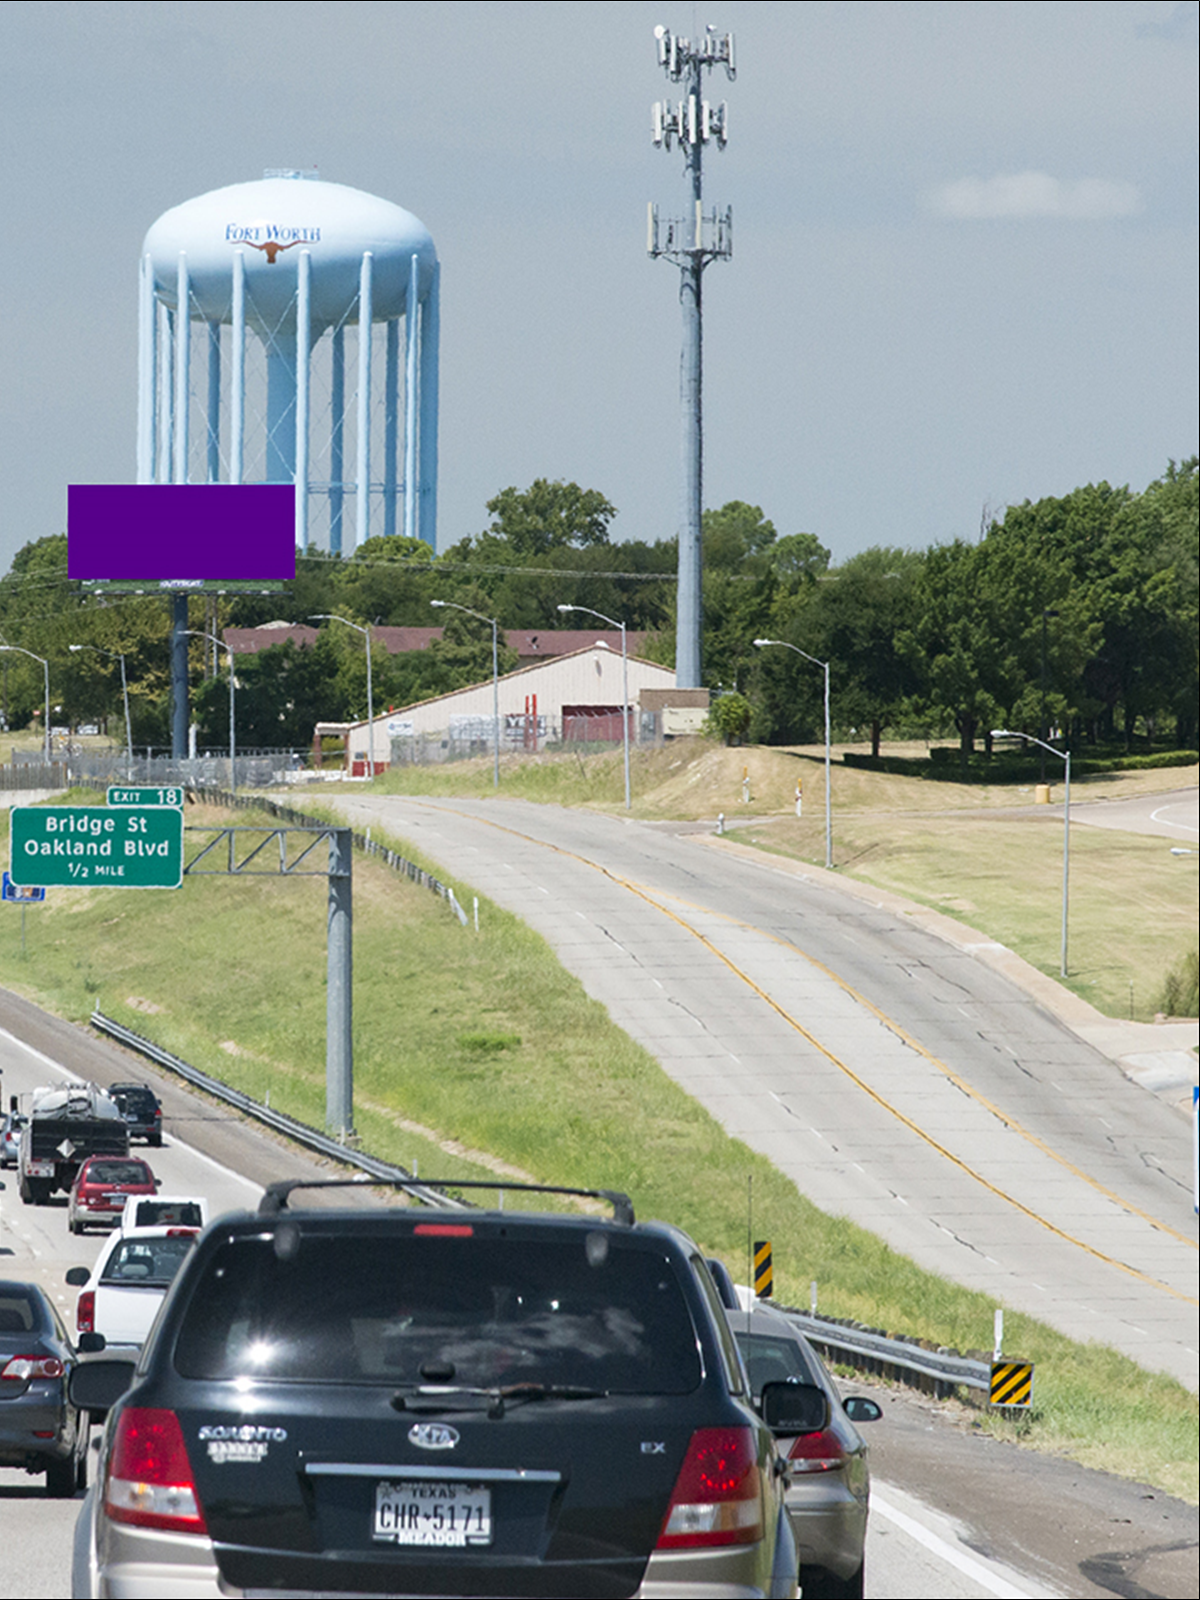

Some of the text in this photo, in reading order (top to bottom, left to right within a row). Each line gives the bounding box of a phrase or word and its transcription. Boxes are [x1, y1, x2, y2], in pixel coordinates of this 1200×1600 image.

[113, 789, 178, 805] EXIT 18
[45, 815, 148, 836] Bridge St
[24, 838, 169, 856] Oakland Blvd
[67, 862, 125, 878] 1/2 MILE
[416, 1425, 453, 1444] KIA
[641, 1441, 666, 1454] EX
[412, 1487, 457, 1498] TEXAS
[398, 1531, 466, 1546] MEADOR
